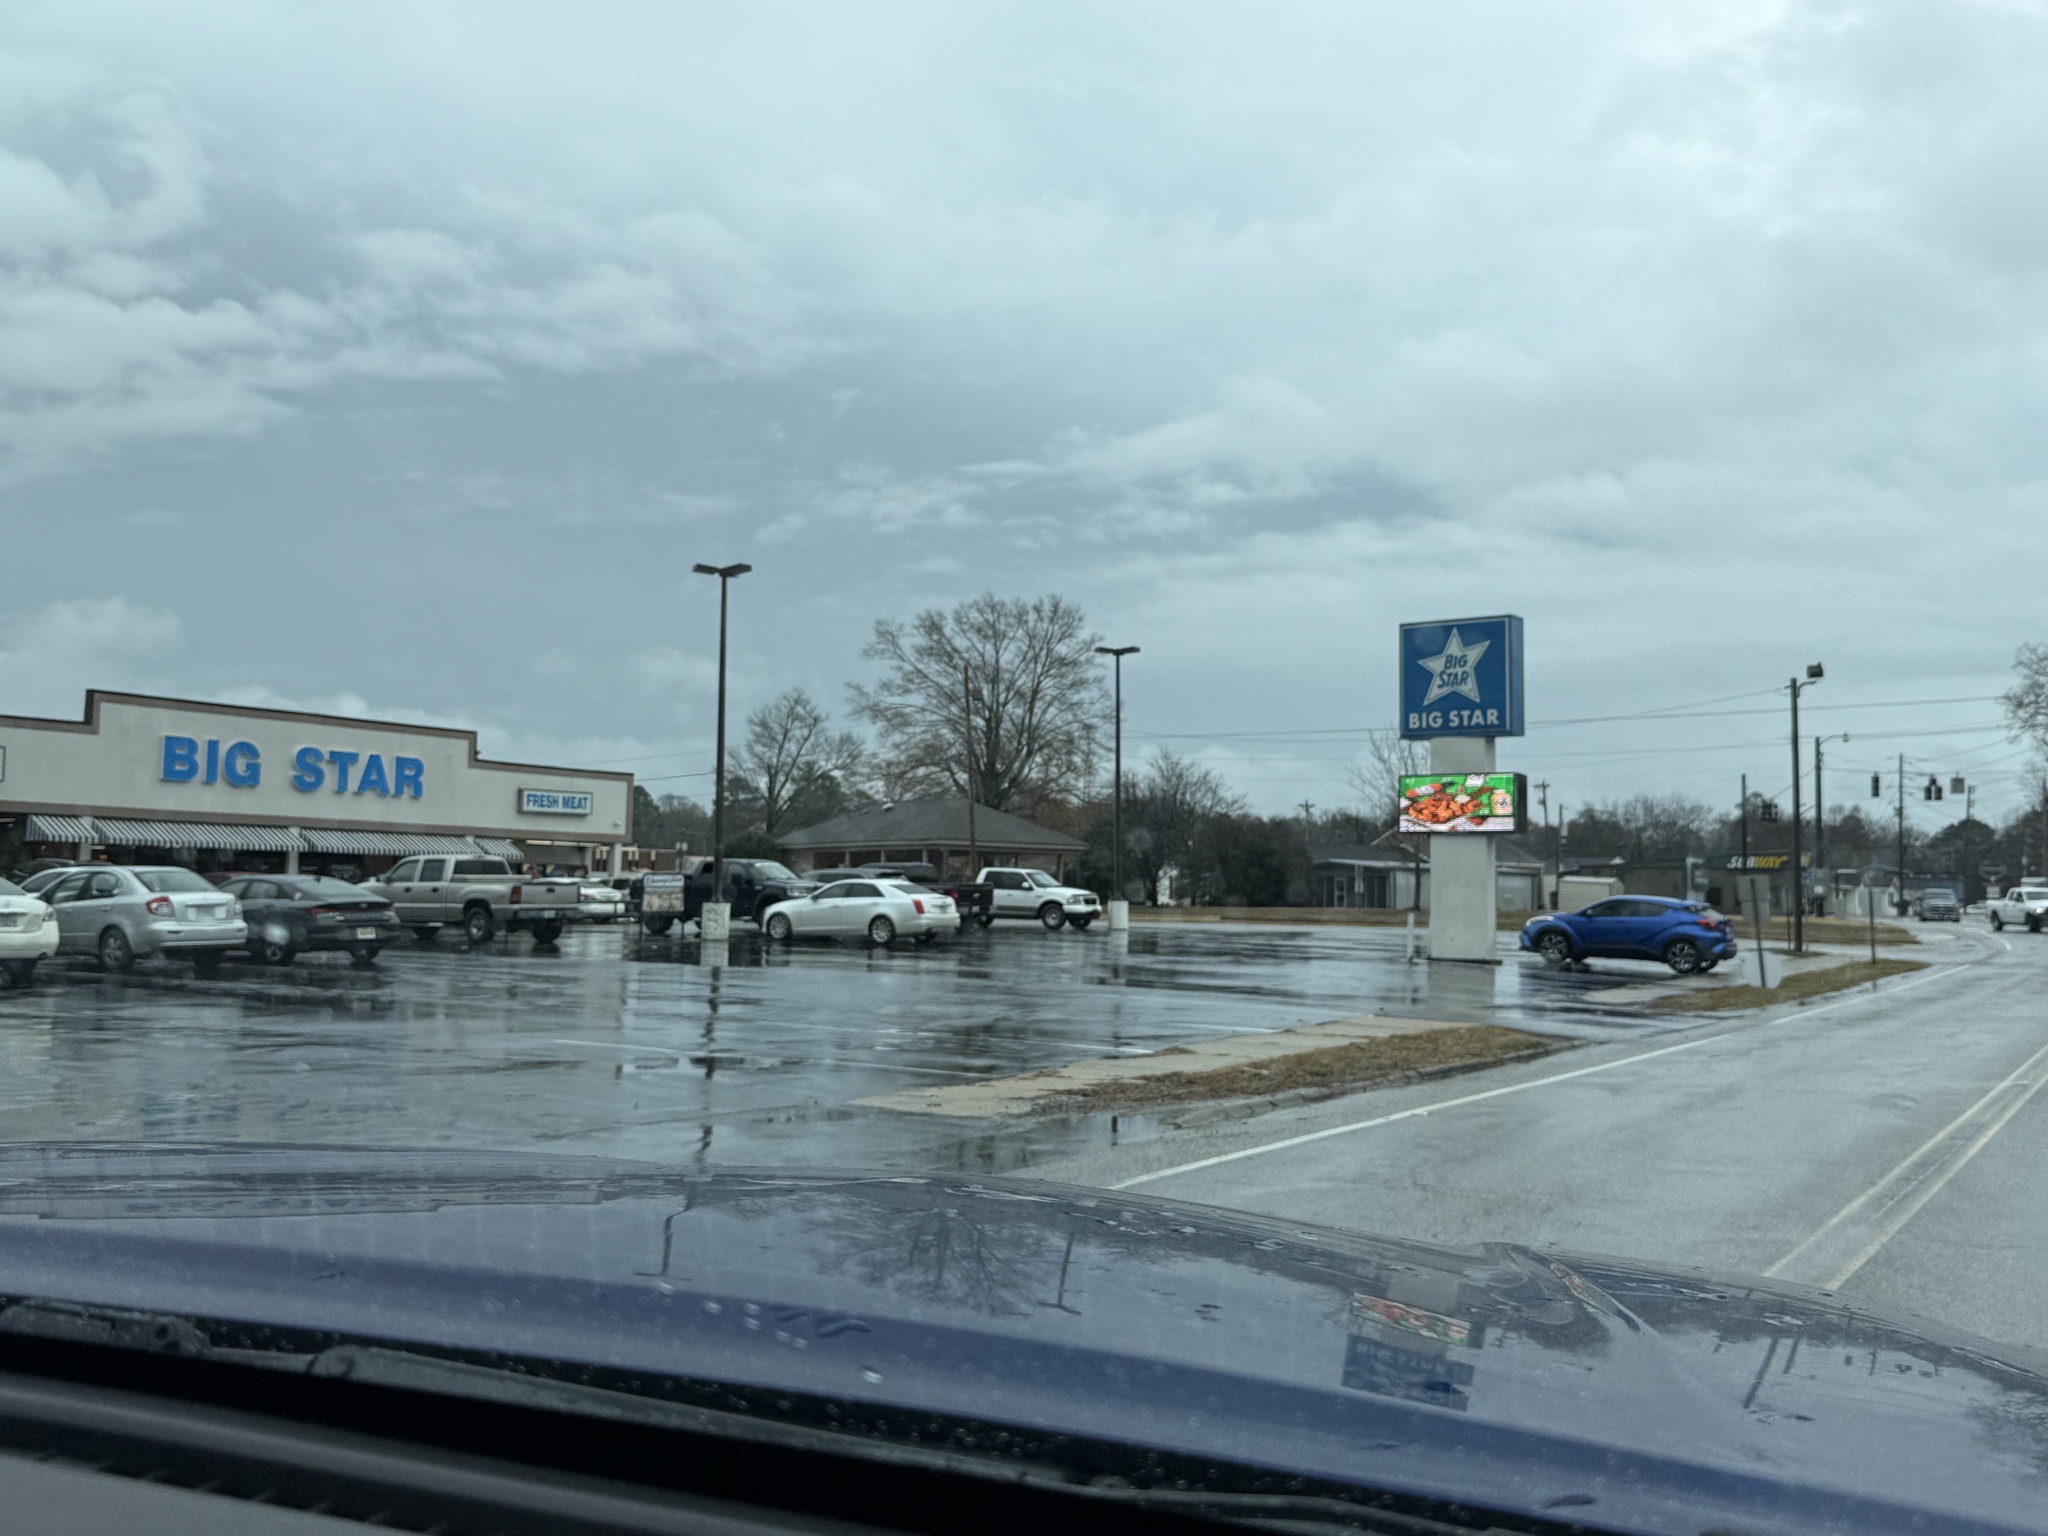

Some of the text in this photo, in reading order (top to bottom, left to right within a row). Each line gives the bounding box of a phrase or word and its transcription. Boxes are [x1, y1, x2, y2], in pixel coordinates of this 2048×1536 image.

[1445, 654, 1469, 670] BIG
[1437, 671, 1469, 689] STAR
[1409, 709, 1499, 729] BIG STAR
[161, 735, 425, 799] BIG STAR
[526, 793, 589, 809] FRESH MEAT
